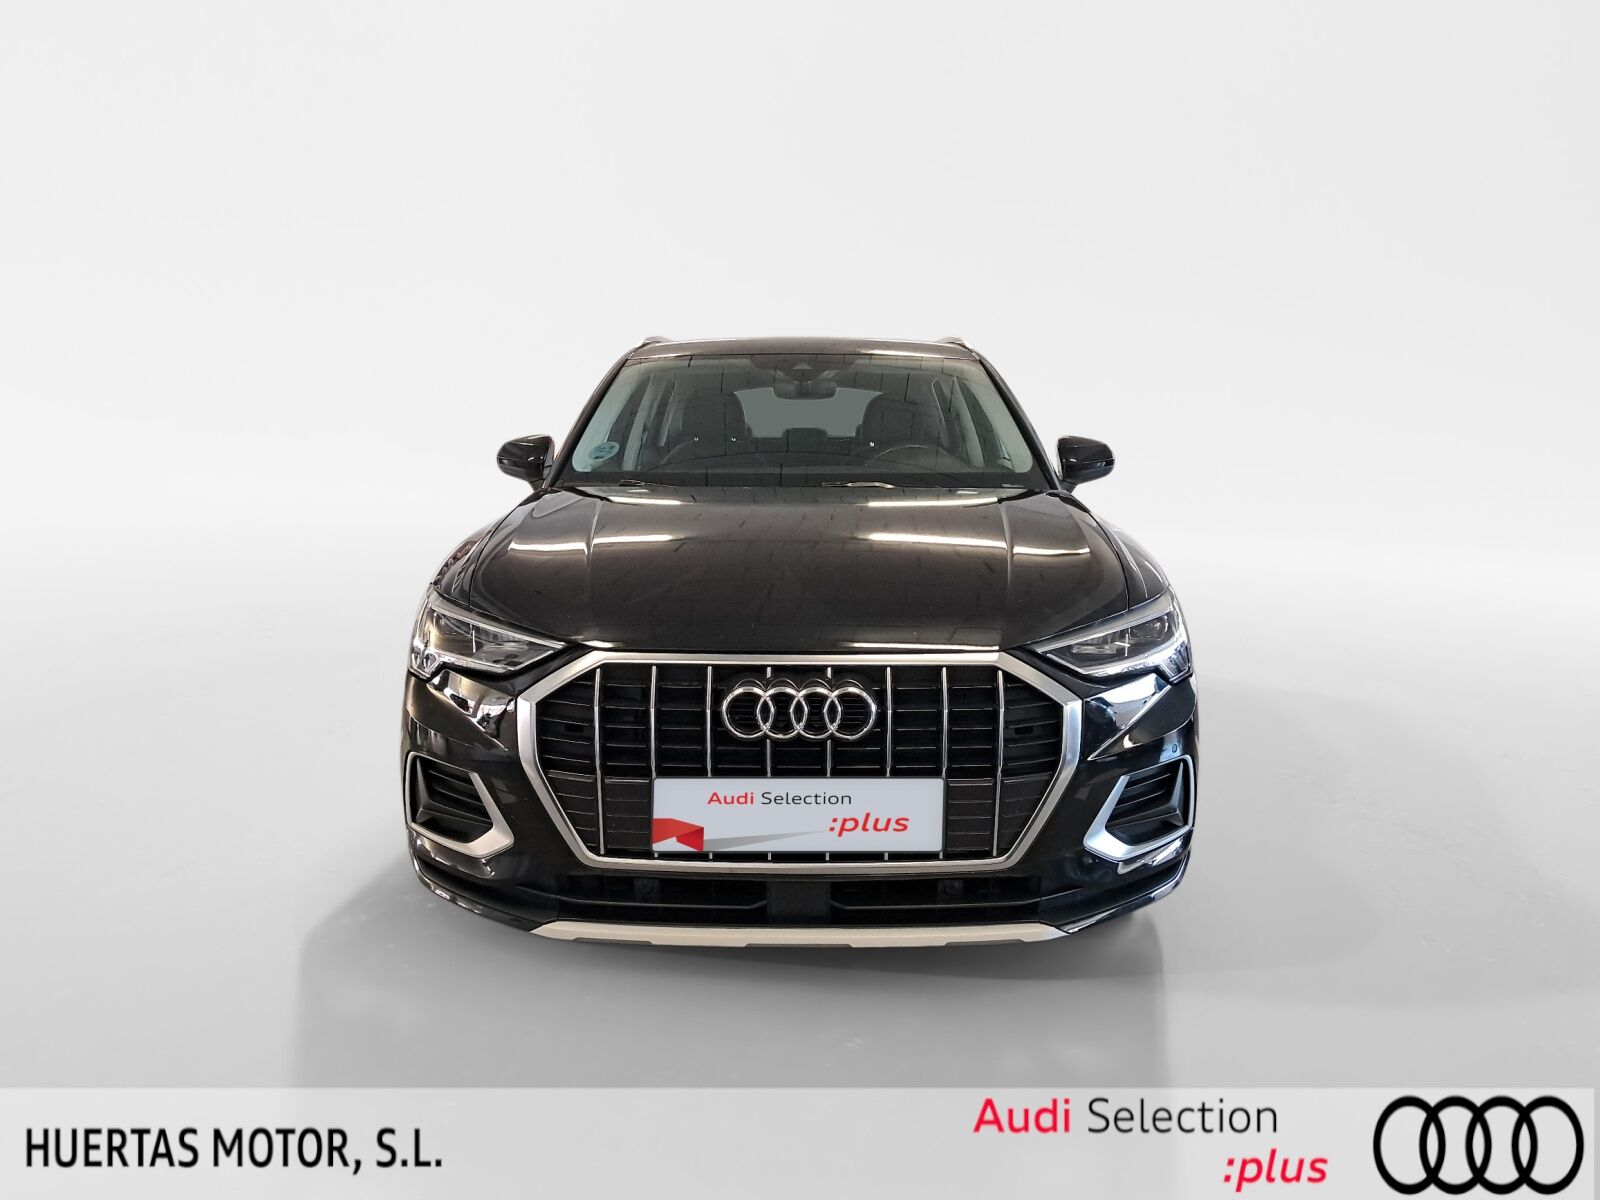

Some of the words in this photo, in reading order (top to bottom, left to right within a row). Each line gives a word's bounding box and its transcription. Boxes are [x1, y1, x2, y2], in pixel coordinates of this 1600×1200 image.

[707, 791, 755, 805] Audi
[761, 791, 852, 805] Selection
[828, 812, 910, 837] :plus
